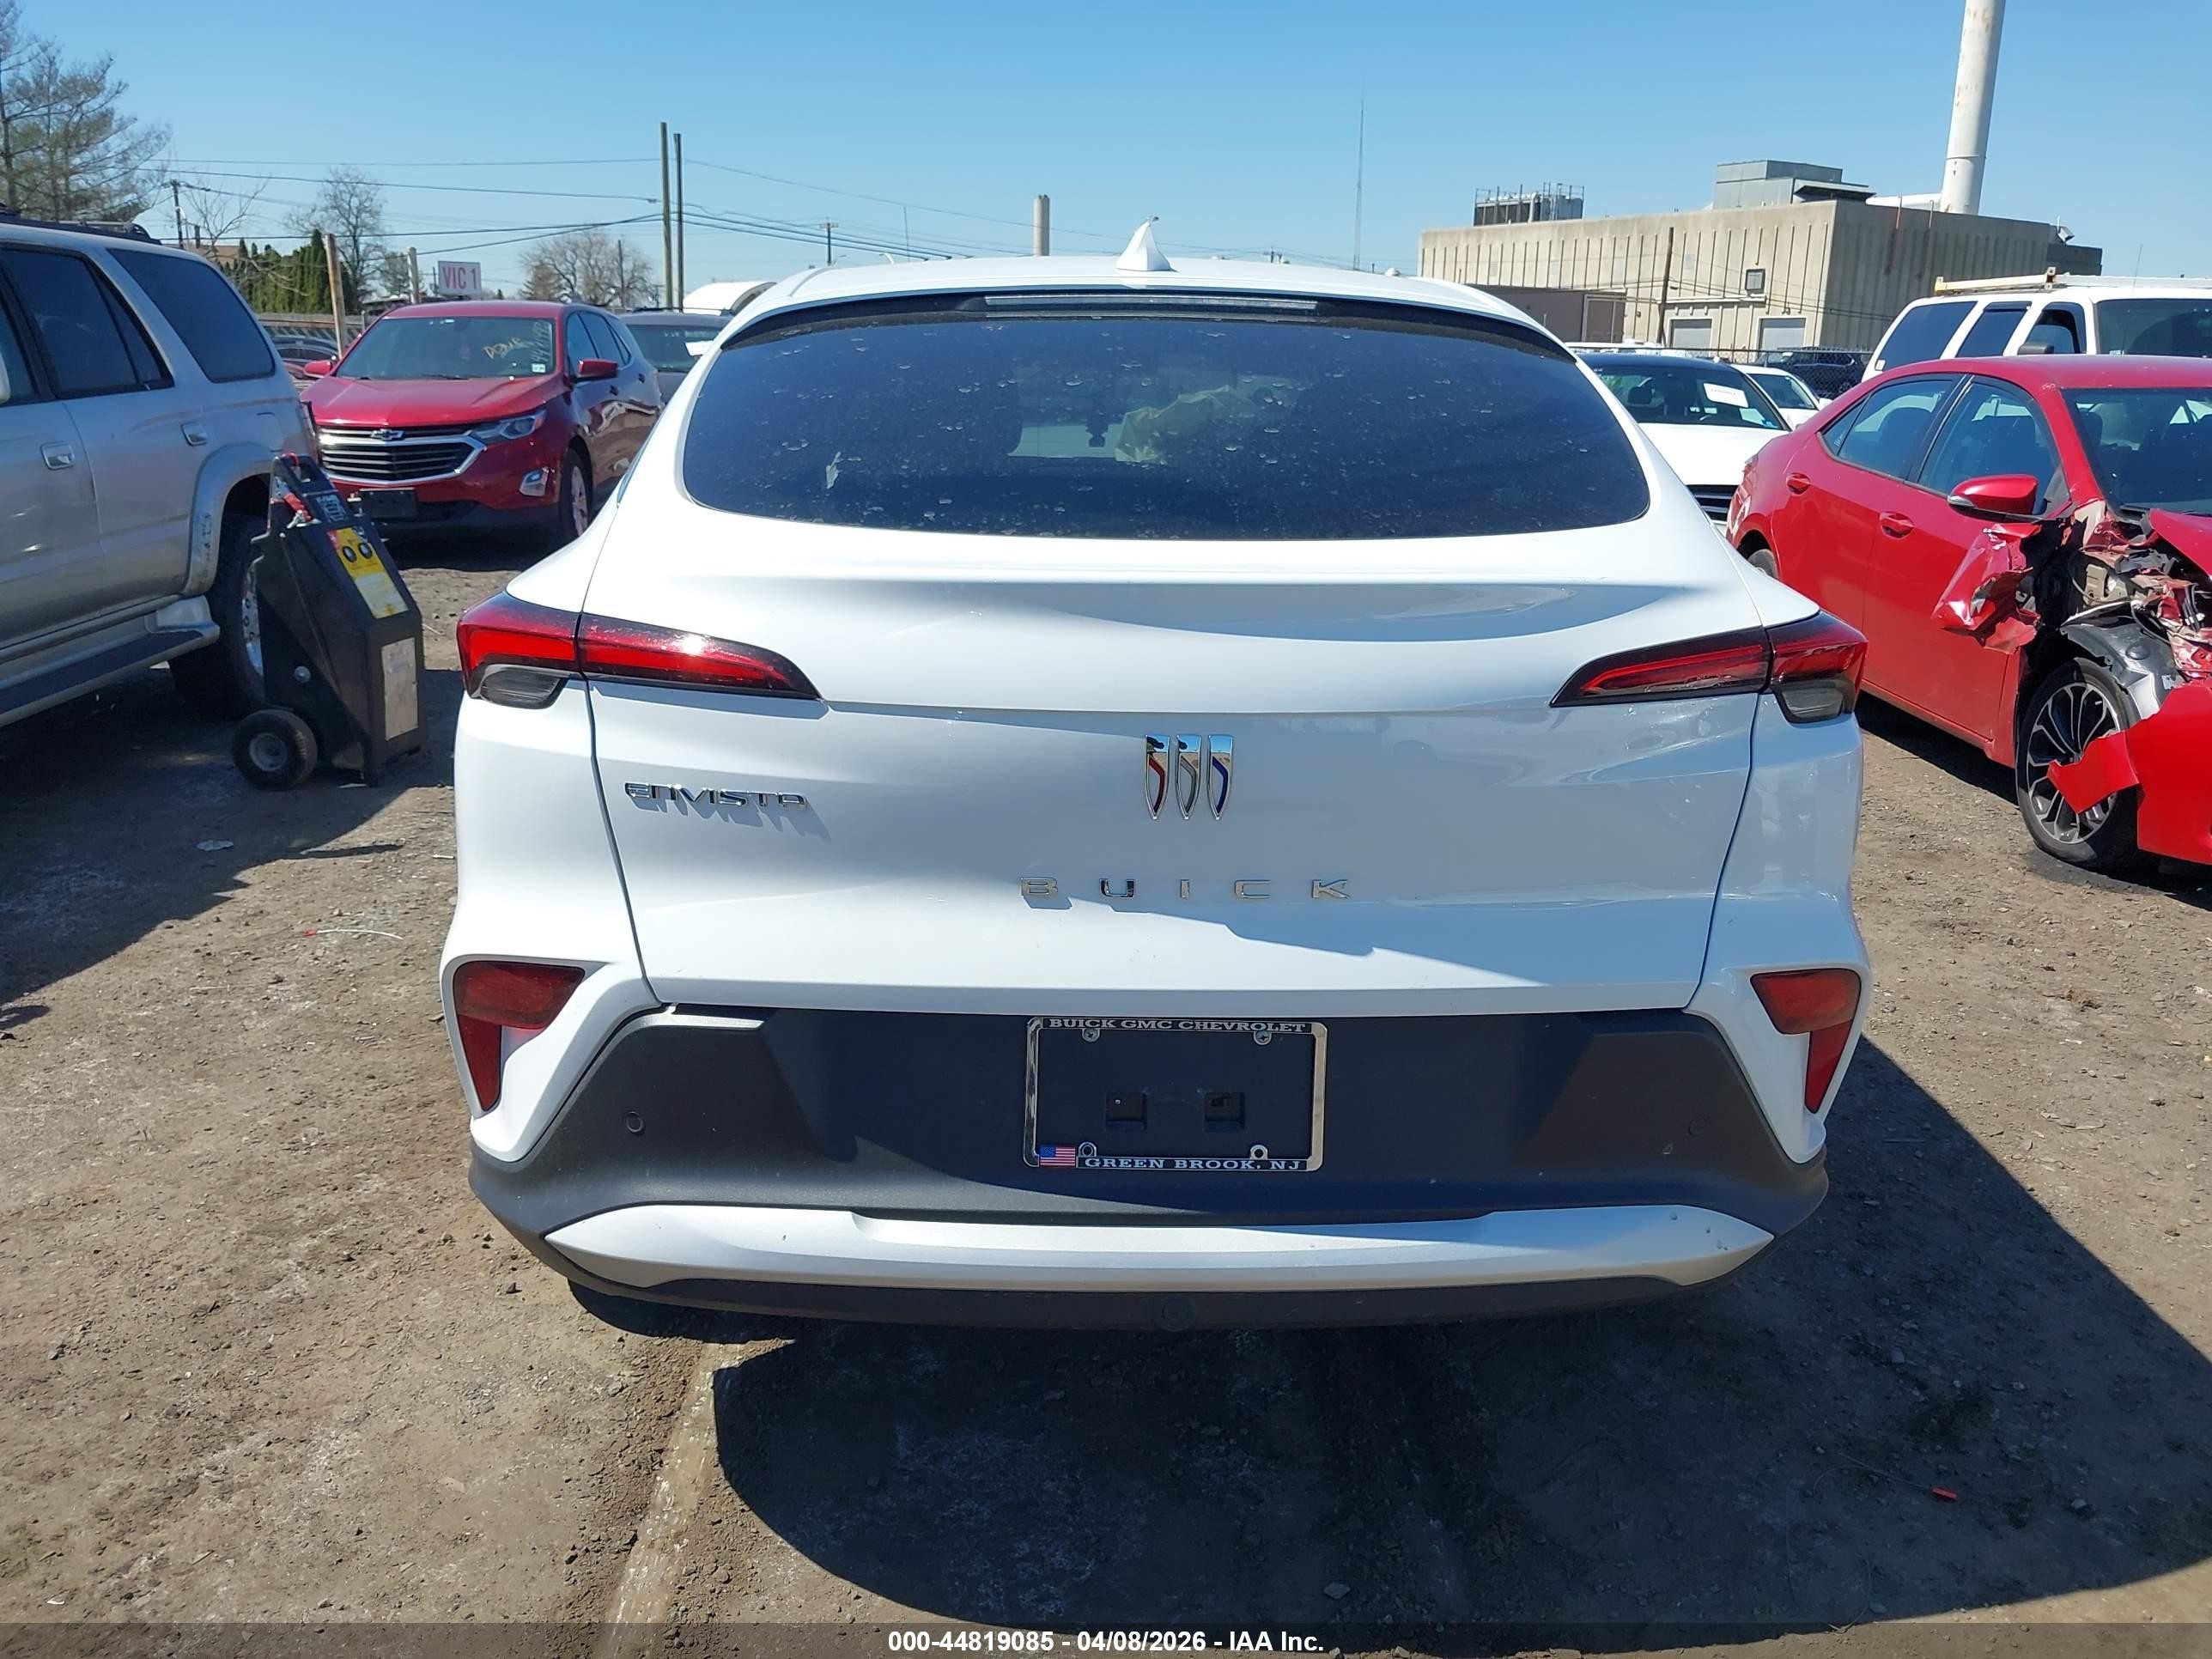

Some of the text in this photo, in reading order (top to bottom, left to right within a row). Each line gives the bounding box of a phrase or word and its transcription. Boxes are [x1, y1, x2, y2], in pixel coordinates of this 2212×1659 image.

[442, 266, 477, 289] VIC 1
[624, 782, 808, 809] ENVISTA
[1020, 878, 1351, 900] BUICK
[1048, 1018, 1306, 1032] BUICK GMC CHEVROLET
[1085, 1158, 1301, 1170] GREEN BROOK, NJ
